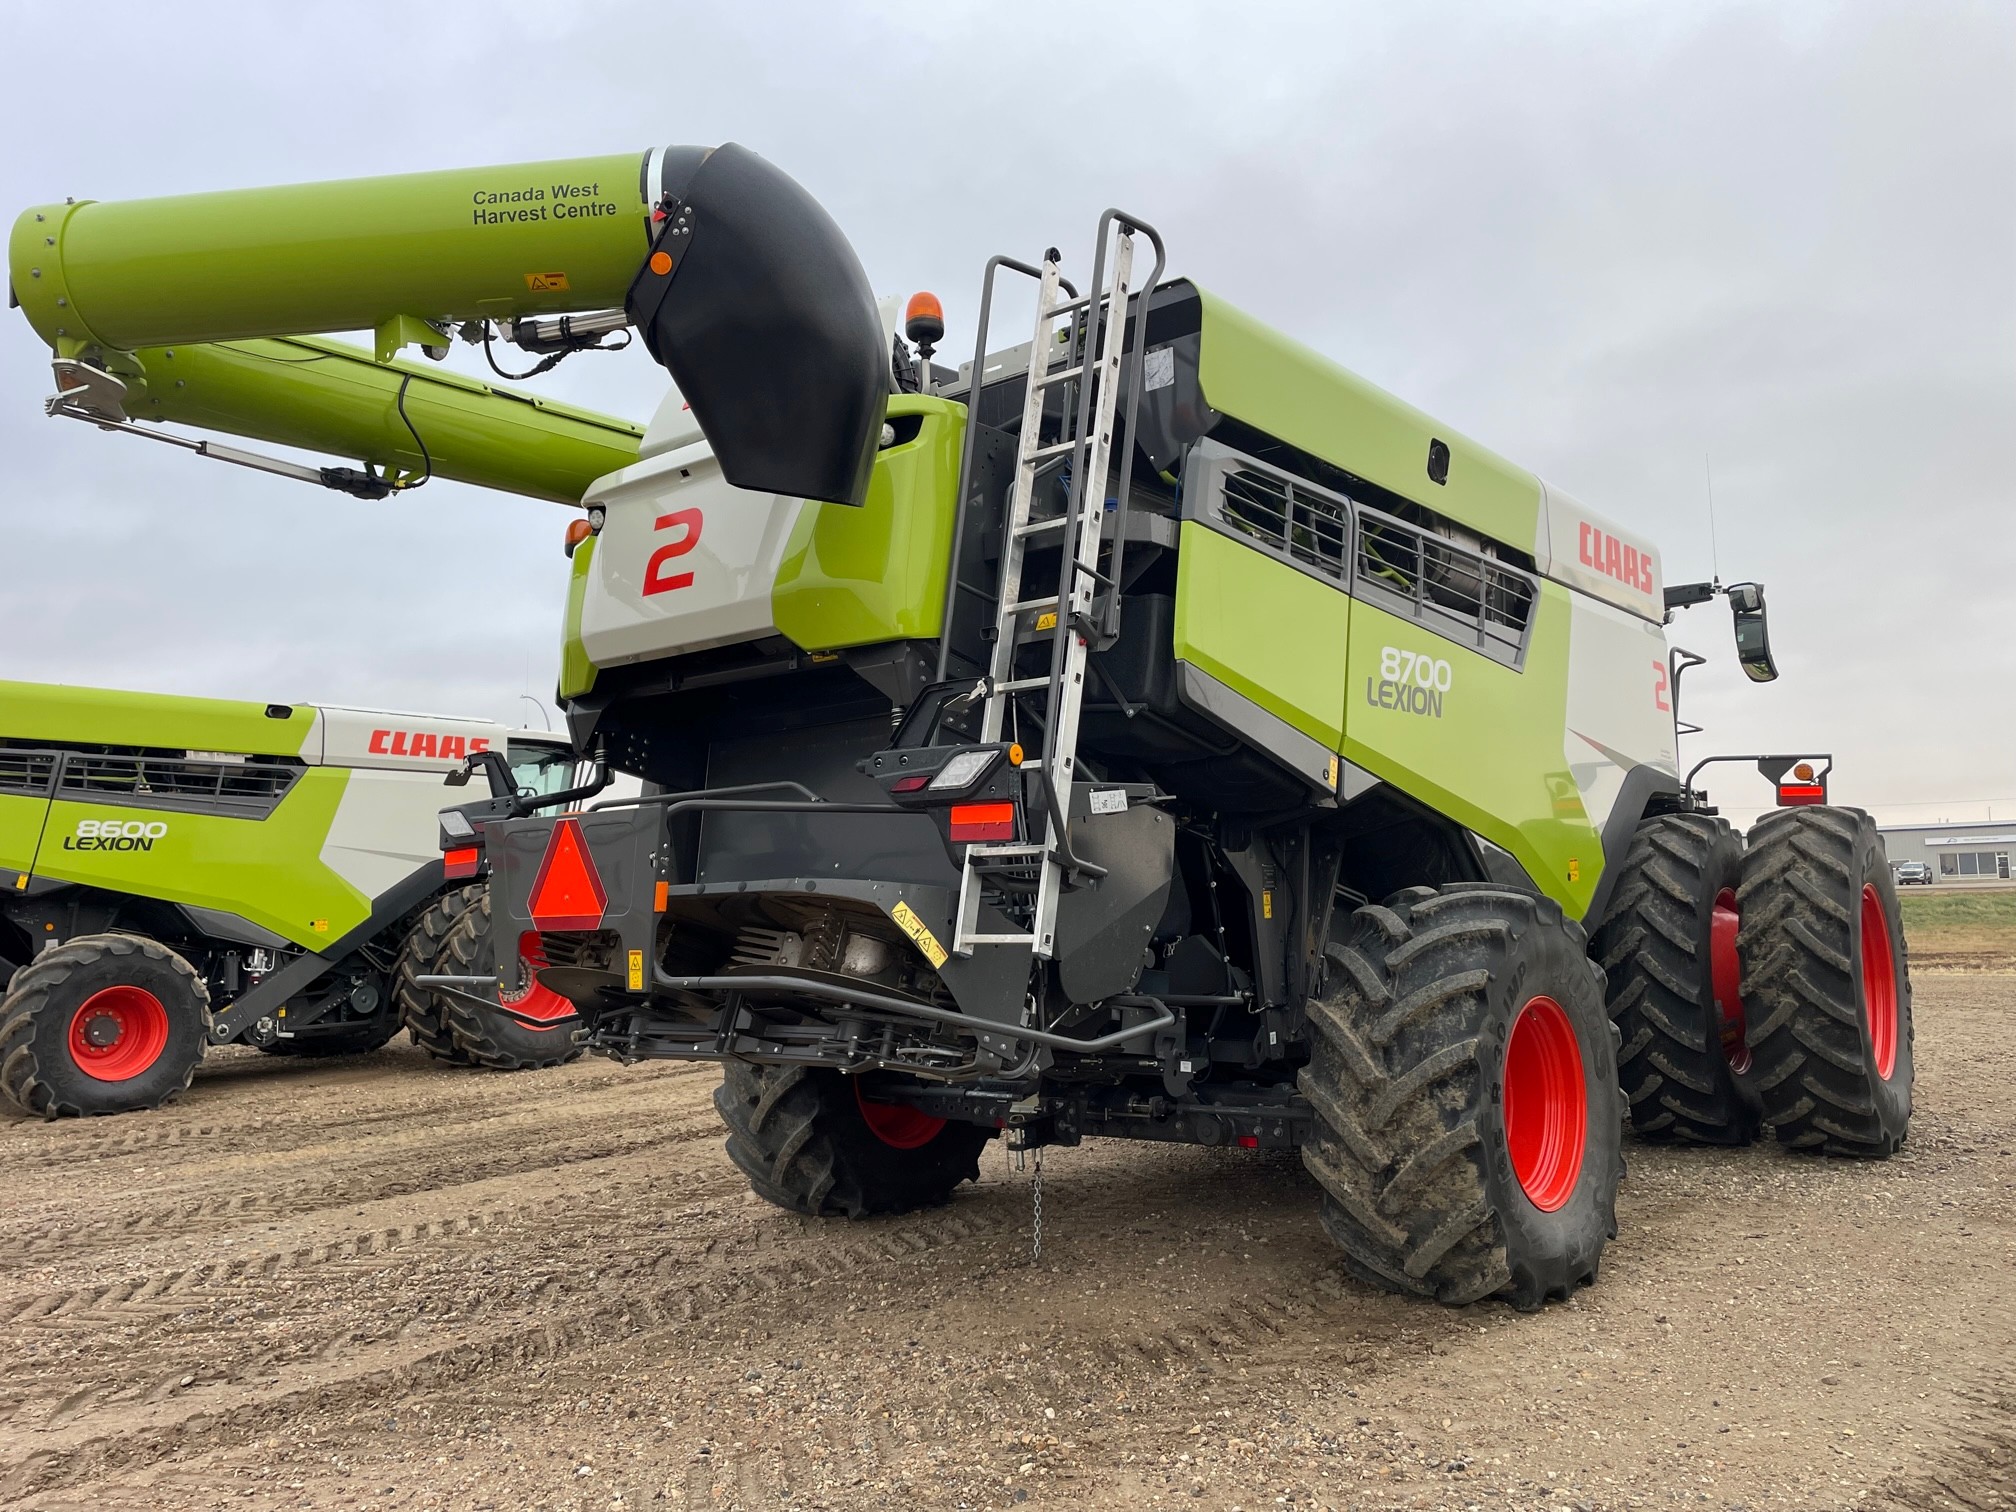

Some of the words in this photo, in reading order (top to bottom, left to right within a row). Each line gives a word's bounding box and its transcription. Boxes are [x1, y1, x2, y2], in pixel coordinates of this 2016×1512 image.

[473, 187, 545, 205] Canada
[551, 182, 599, 199] West
[473, 205, 547, 225] Harvest
[553, 201, 617, 219] Centre
[642, 507, 704, 597] 2
[1579, 521, 1652, 595] CLAAS
[1381, 646, 1452, 692] 8700
[1652, 660, 1669, 712] 2
[1367, 676, 1443, 718] LEXION
[368, 729, 490, 760] CLAAS
[63, 836, 154, 851] LEXION
[76, 819, 168, 839] 8600
